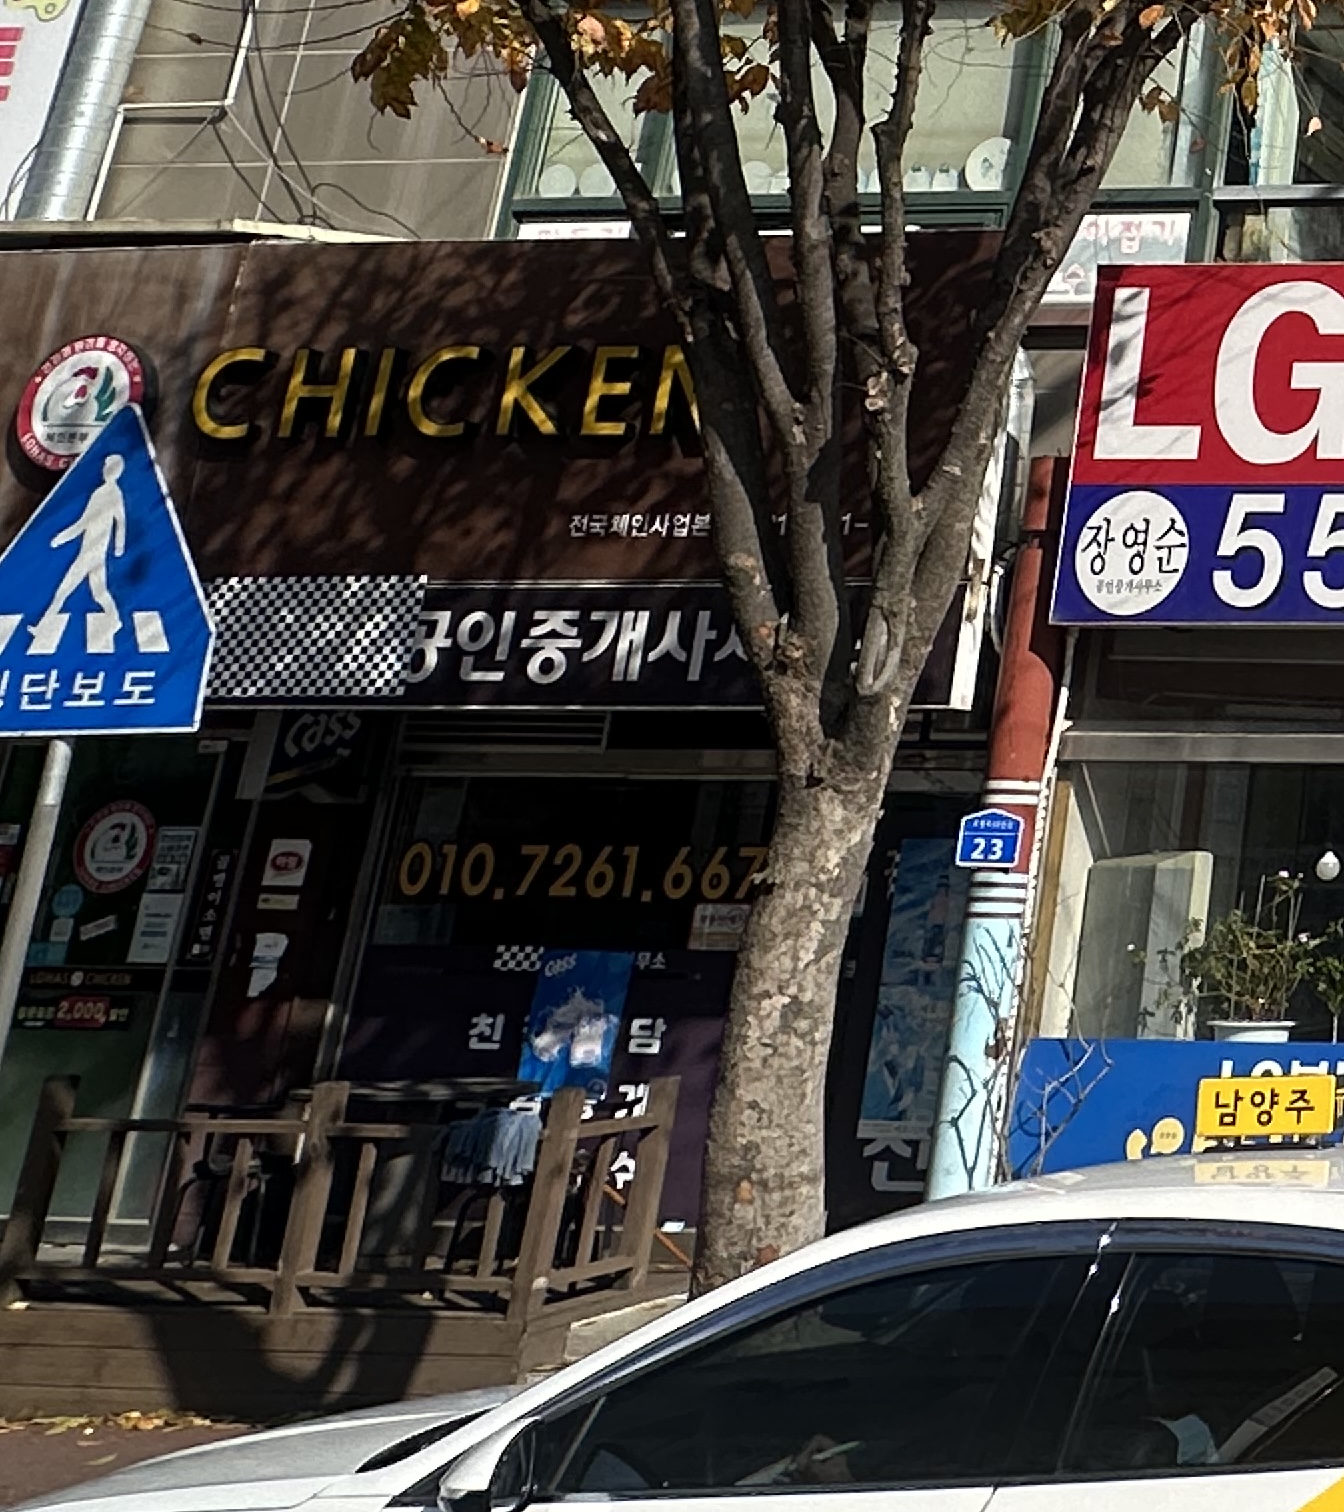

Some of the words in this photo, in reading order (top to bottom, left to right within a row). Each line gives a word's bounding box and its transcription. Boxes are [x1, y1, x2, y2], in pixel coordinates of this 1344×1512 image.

[192, 345, 703, 440] CHICKEN
[1080, 517, 1189, 575] 장영순
[0, 669, 157, 711] 단보도
[970, 836, 1004, 860] 23
[1214, 1087, 1316, 1128] 남양주
